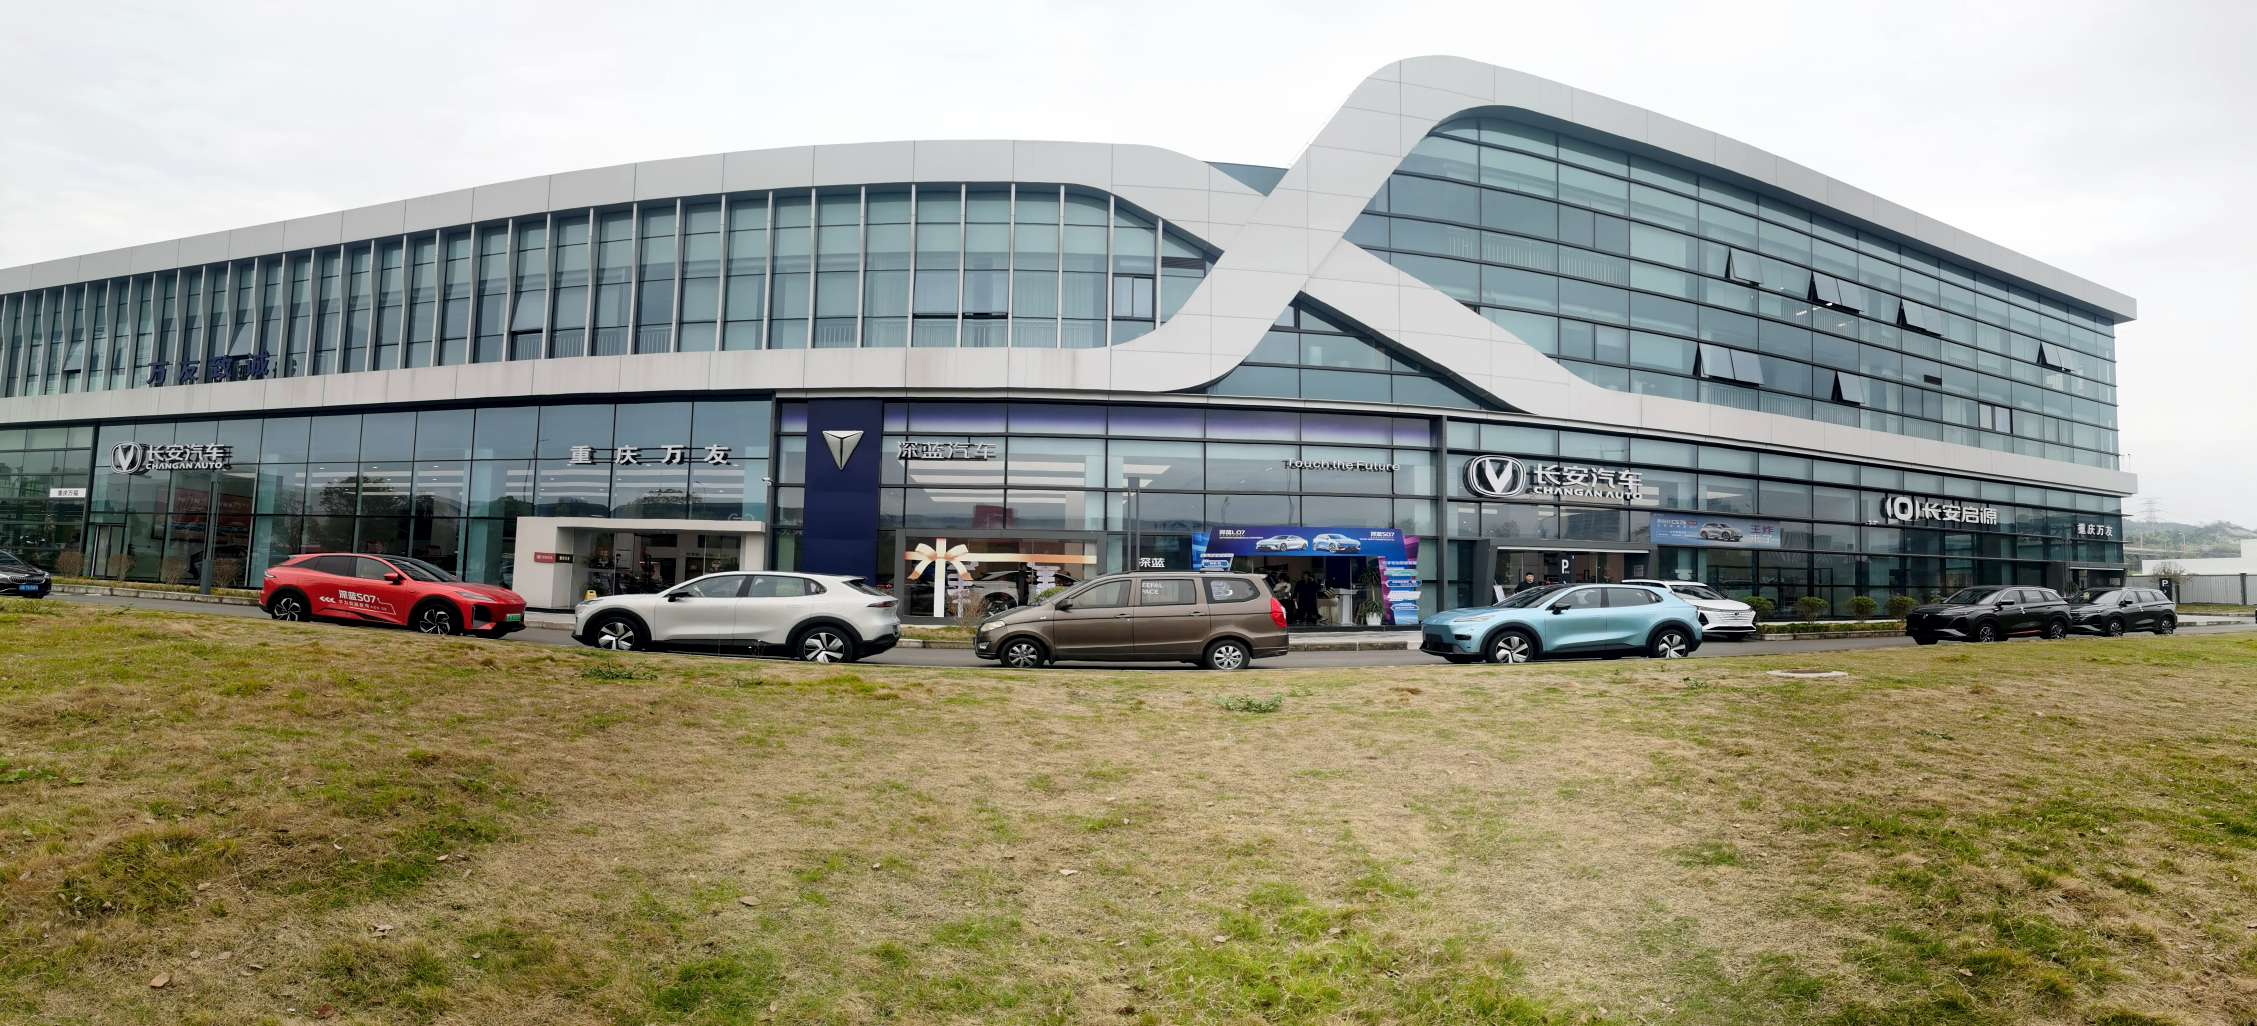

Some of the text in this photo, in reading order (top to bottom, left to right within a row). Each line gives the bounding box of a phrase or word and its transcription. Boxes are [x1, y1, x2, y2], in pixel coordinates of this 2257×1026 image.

[146, 350, 271, 385] 万友致诚
[146, 442, 225, 461] 长安汽车
[569, 444, 729, 464] 重庆万友
[896, 441, 996, 459] 深蓝汽车
[145, 462, 193, 470] CHANGAN
[1286, 458, 1400, 471] Touch the Future
[1534, 463, 1643, 490] 长安汽车
[1533, 486, 1643, 500] CHANGAN AUTO
[1922, 501, 1998, 525] 长安启源
[1750, 525, 1774, 534] 王炸
[2077, 523, 2113, 537] 重庆万友
[1749, 535, 1773, 544] 来了
[1139, 557, 1166, 568] 深蓝
[1561, 559, 1569, 574] P
[2161, 579, 2169, 587] P
[338, 590, 376, 603] 深蓝S07
